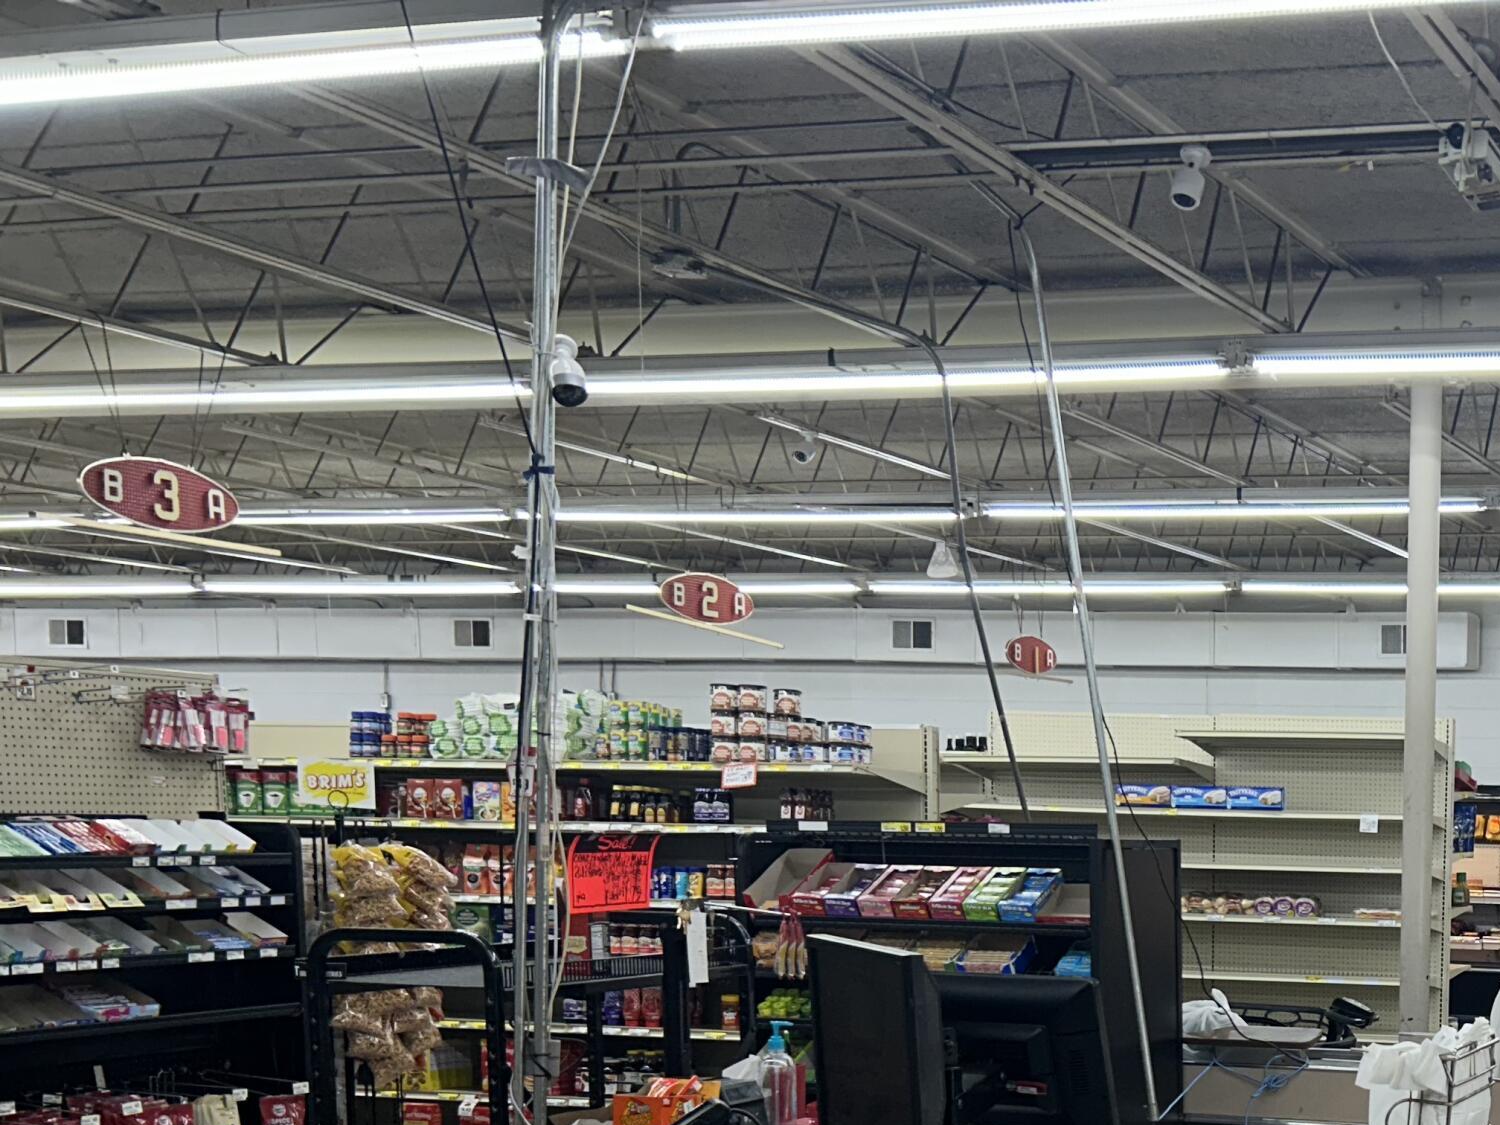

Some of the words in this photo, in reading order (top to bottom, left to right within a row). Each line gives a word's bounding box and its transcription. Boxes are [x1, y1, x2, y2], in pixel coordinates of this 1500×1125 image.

[103, 468, 124, 503] B
[153, 469, 181, 522] 3
[207, 488, 226, 521] A
[673, 582, 685, 607] B
[702, 581, 719, 618] 2
[734, 592, 746, 616] A
[1014, 642, 1022, 662] B
[1046, 648, 1054, 667] A
[306, 769, 366, 790] BRIM'S
